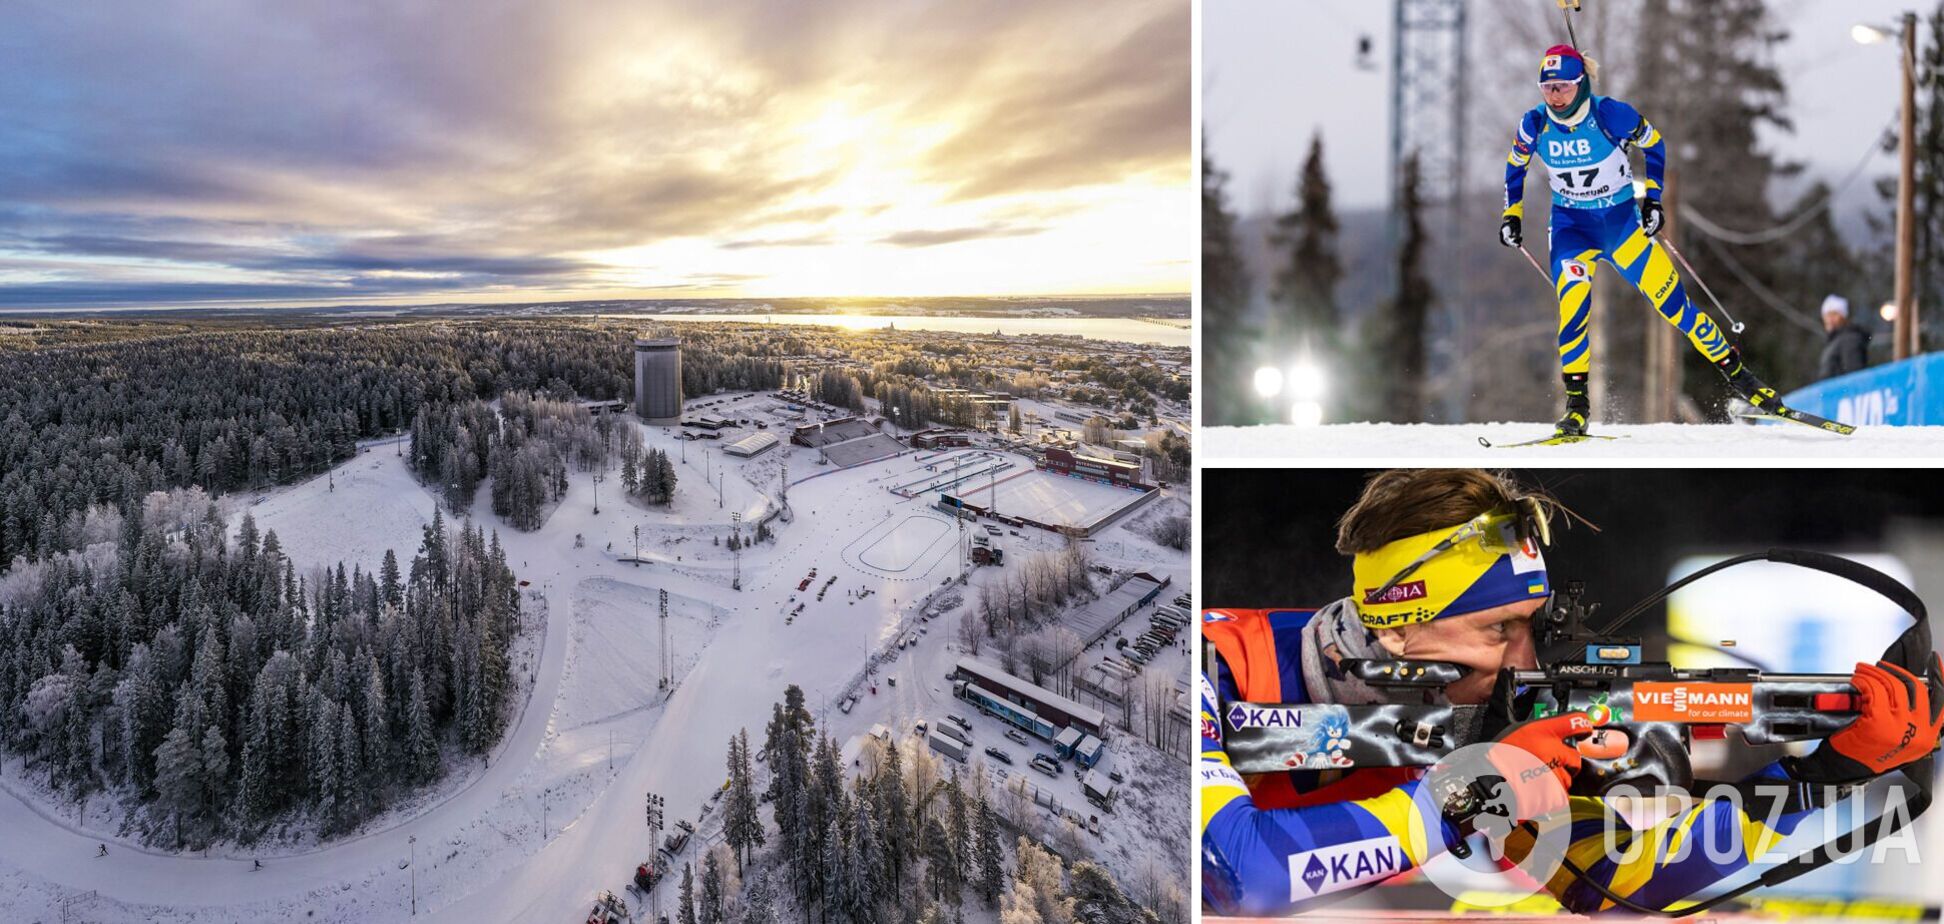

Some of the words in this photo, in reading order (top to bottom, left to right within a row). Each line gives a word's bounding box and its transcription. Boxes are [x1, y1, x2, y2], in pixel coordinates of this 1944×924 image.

[1547, 138, 1591, 157] DKB
[1556, 168, 1599, 188] 17
[1655, 269, 1677, 299] CRAFT
[1361, 612, 1413, 625] CRAFT
[1636, 687, 1749, 712] VIESSMANN
[1250, 709, 1301, 727] KAN
[1688, 709, 1701, 717] for
[1718, 709, 1749, 717] climate
[1330, 845, 1395, 883] KAN
[1305, 869, 1325, 881] KAN
